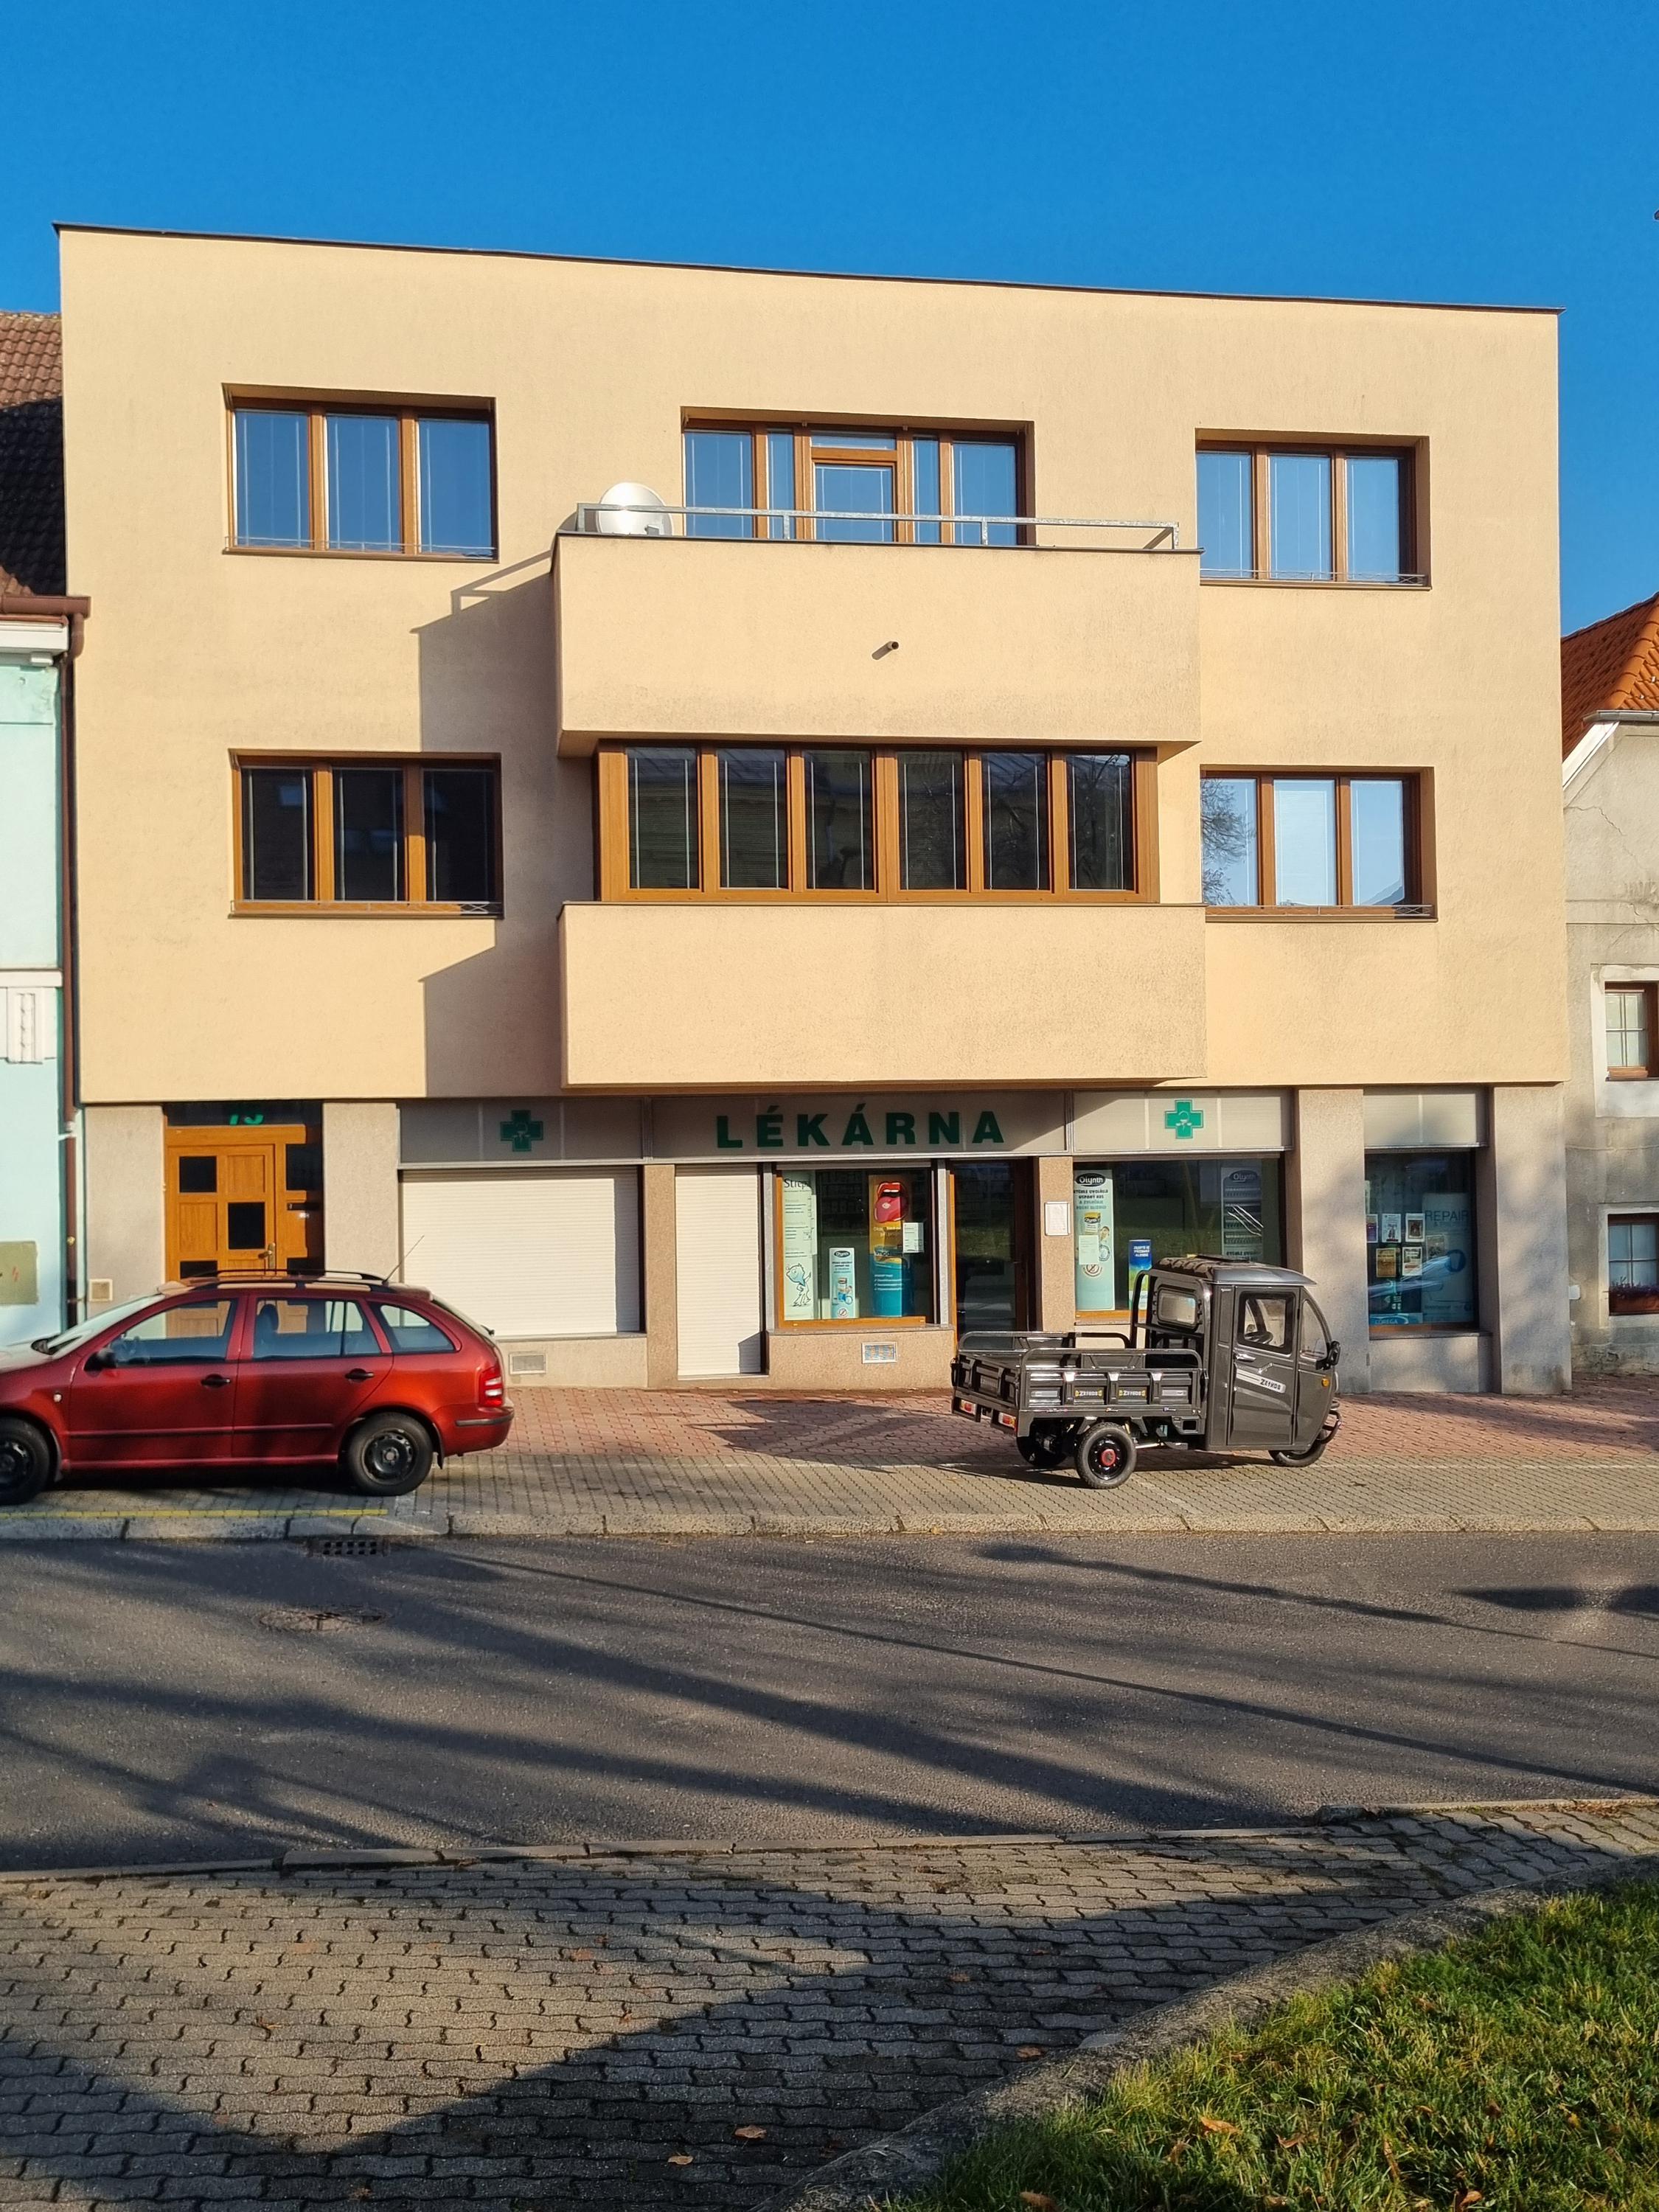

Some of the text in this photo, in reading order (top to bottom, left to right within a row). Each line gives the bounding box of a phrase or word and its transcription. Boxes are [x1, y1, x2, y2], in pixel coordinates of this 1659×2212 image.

[716, 1103, 1004, 1148] LÉKÁRNA
[1079, 1177, 1104, 1185] Olynth
[1425, 1210, 1469, 1221] REPAIR
